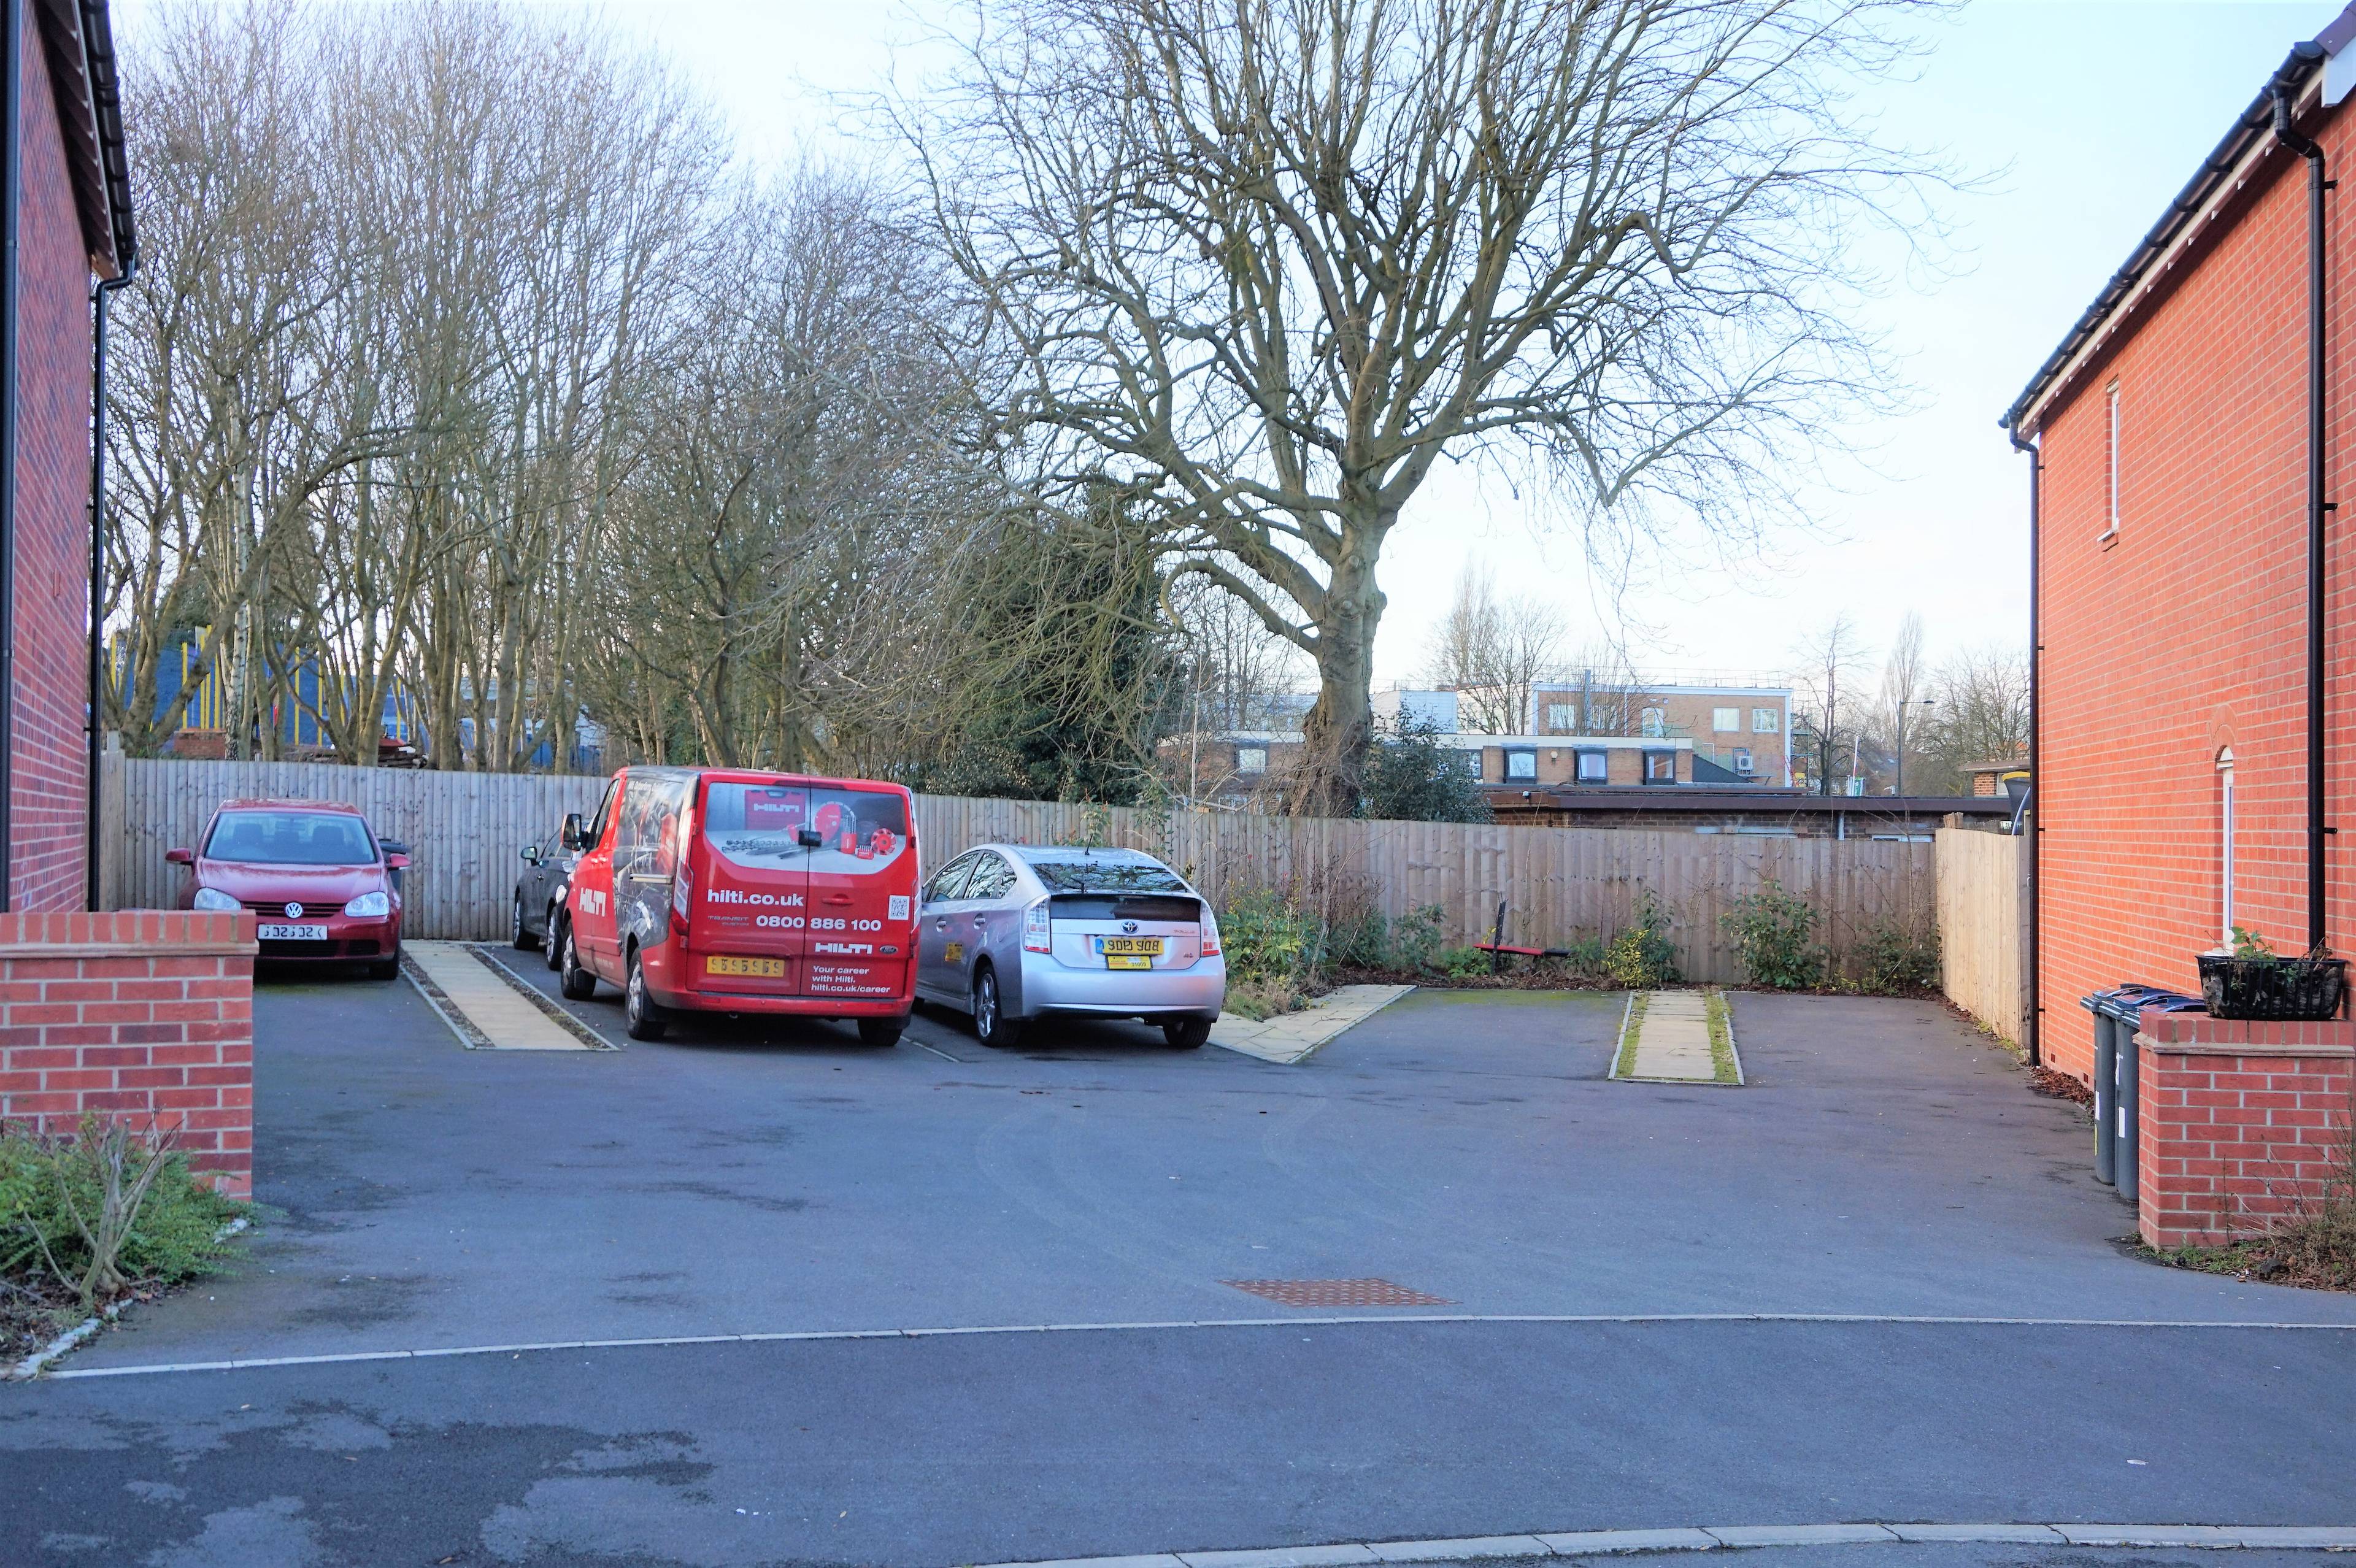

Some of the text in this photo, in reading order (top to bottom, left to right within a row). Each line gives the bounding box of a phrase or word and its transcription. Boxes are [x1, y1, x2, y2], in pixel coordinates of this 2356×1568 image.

[753, 804, 799, 813] HILTI
[579, 887, 607, 917] HILTI
[707, 888, 804, 907] hilti.co.uk
[756, 915, 882, 931] 0800 886 100
[815, 942, 872, 955] HILTI
[811, 983, 890, 993] hilti.co.uk/career
